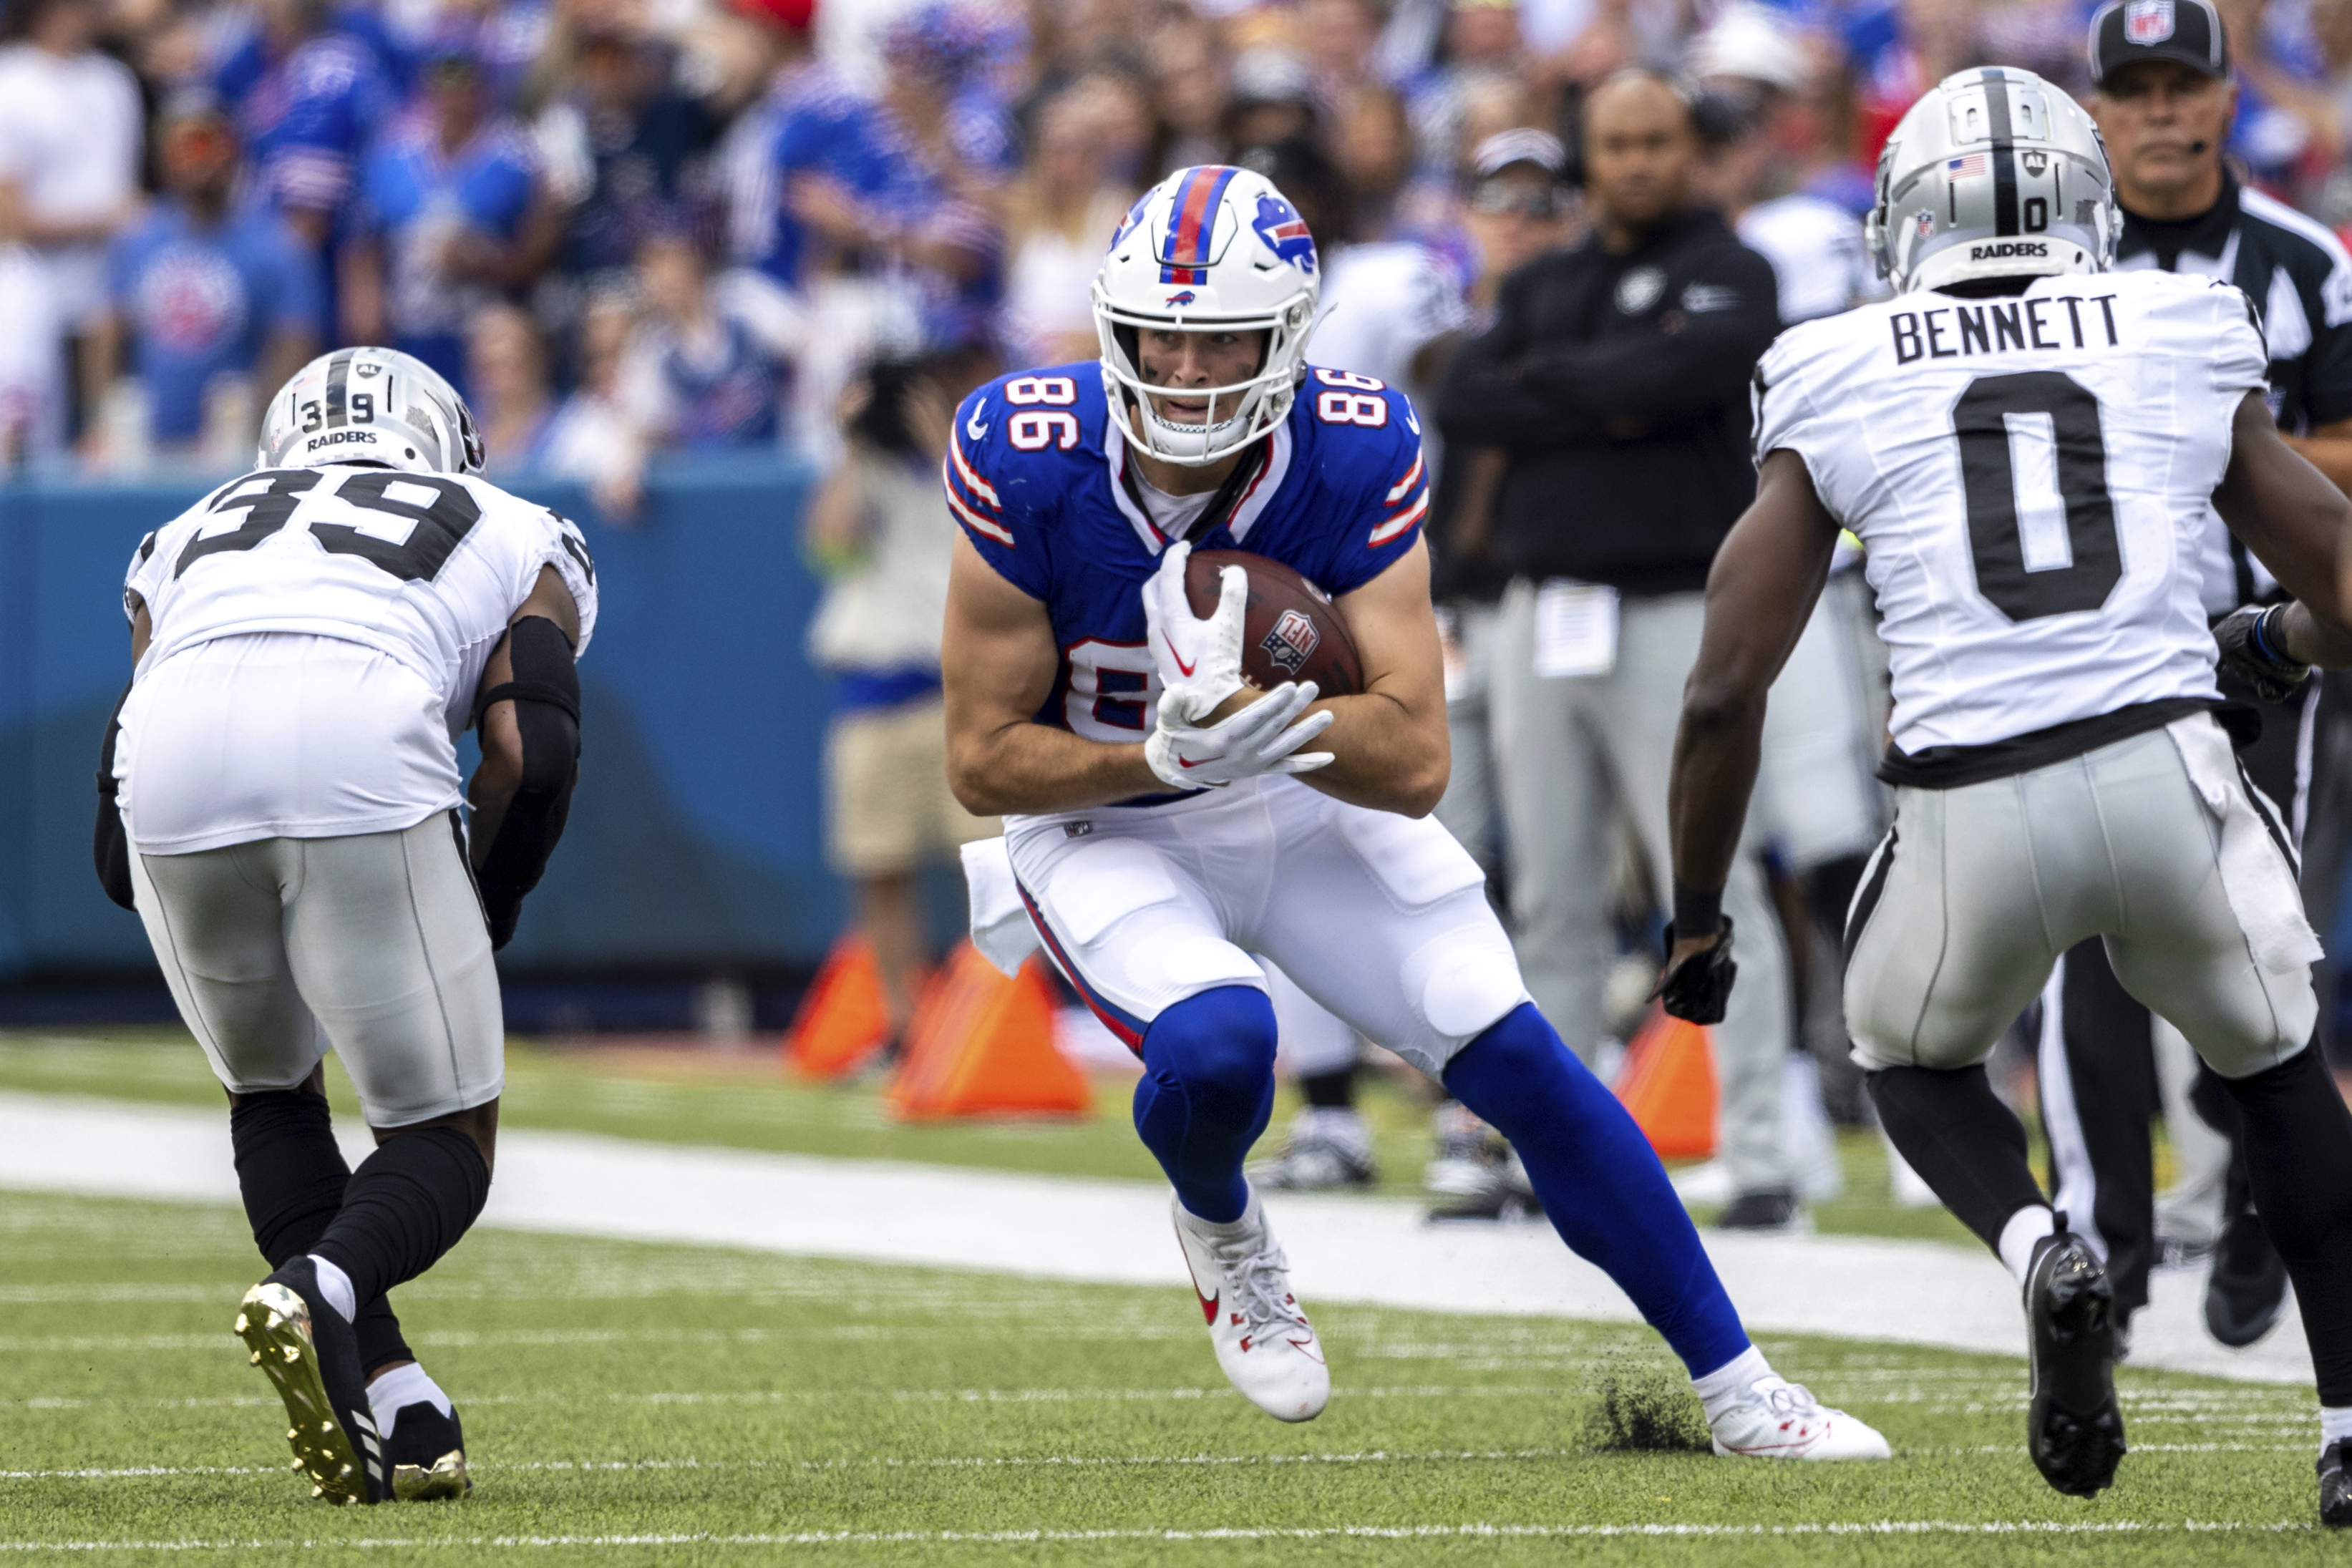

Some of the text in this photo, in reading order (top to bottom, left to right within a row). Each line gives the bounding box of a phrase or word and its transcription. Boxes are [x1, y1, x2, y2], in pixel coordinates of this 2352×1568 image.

[2025, 157, 2044, 168] AL
[2023, 196, 2048, 233] 0
[1970, 243, 2048, 261] RAIDERS
[1890, 293, 2119, 366] BENNETT
[358, 364, 377, 374] AL
[301, 393, 374, 434] 39
[1003, 376, 1082, 452] 86
[1313, 368, 1390, 430] 86
[307, 431, 377, 453] RAIDERS
[1952, 370, 2127, 627] 0
[172, 468, 487, 584] 39
[1281, 615, 1316, 657] NFL
